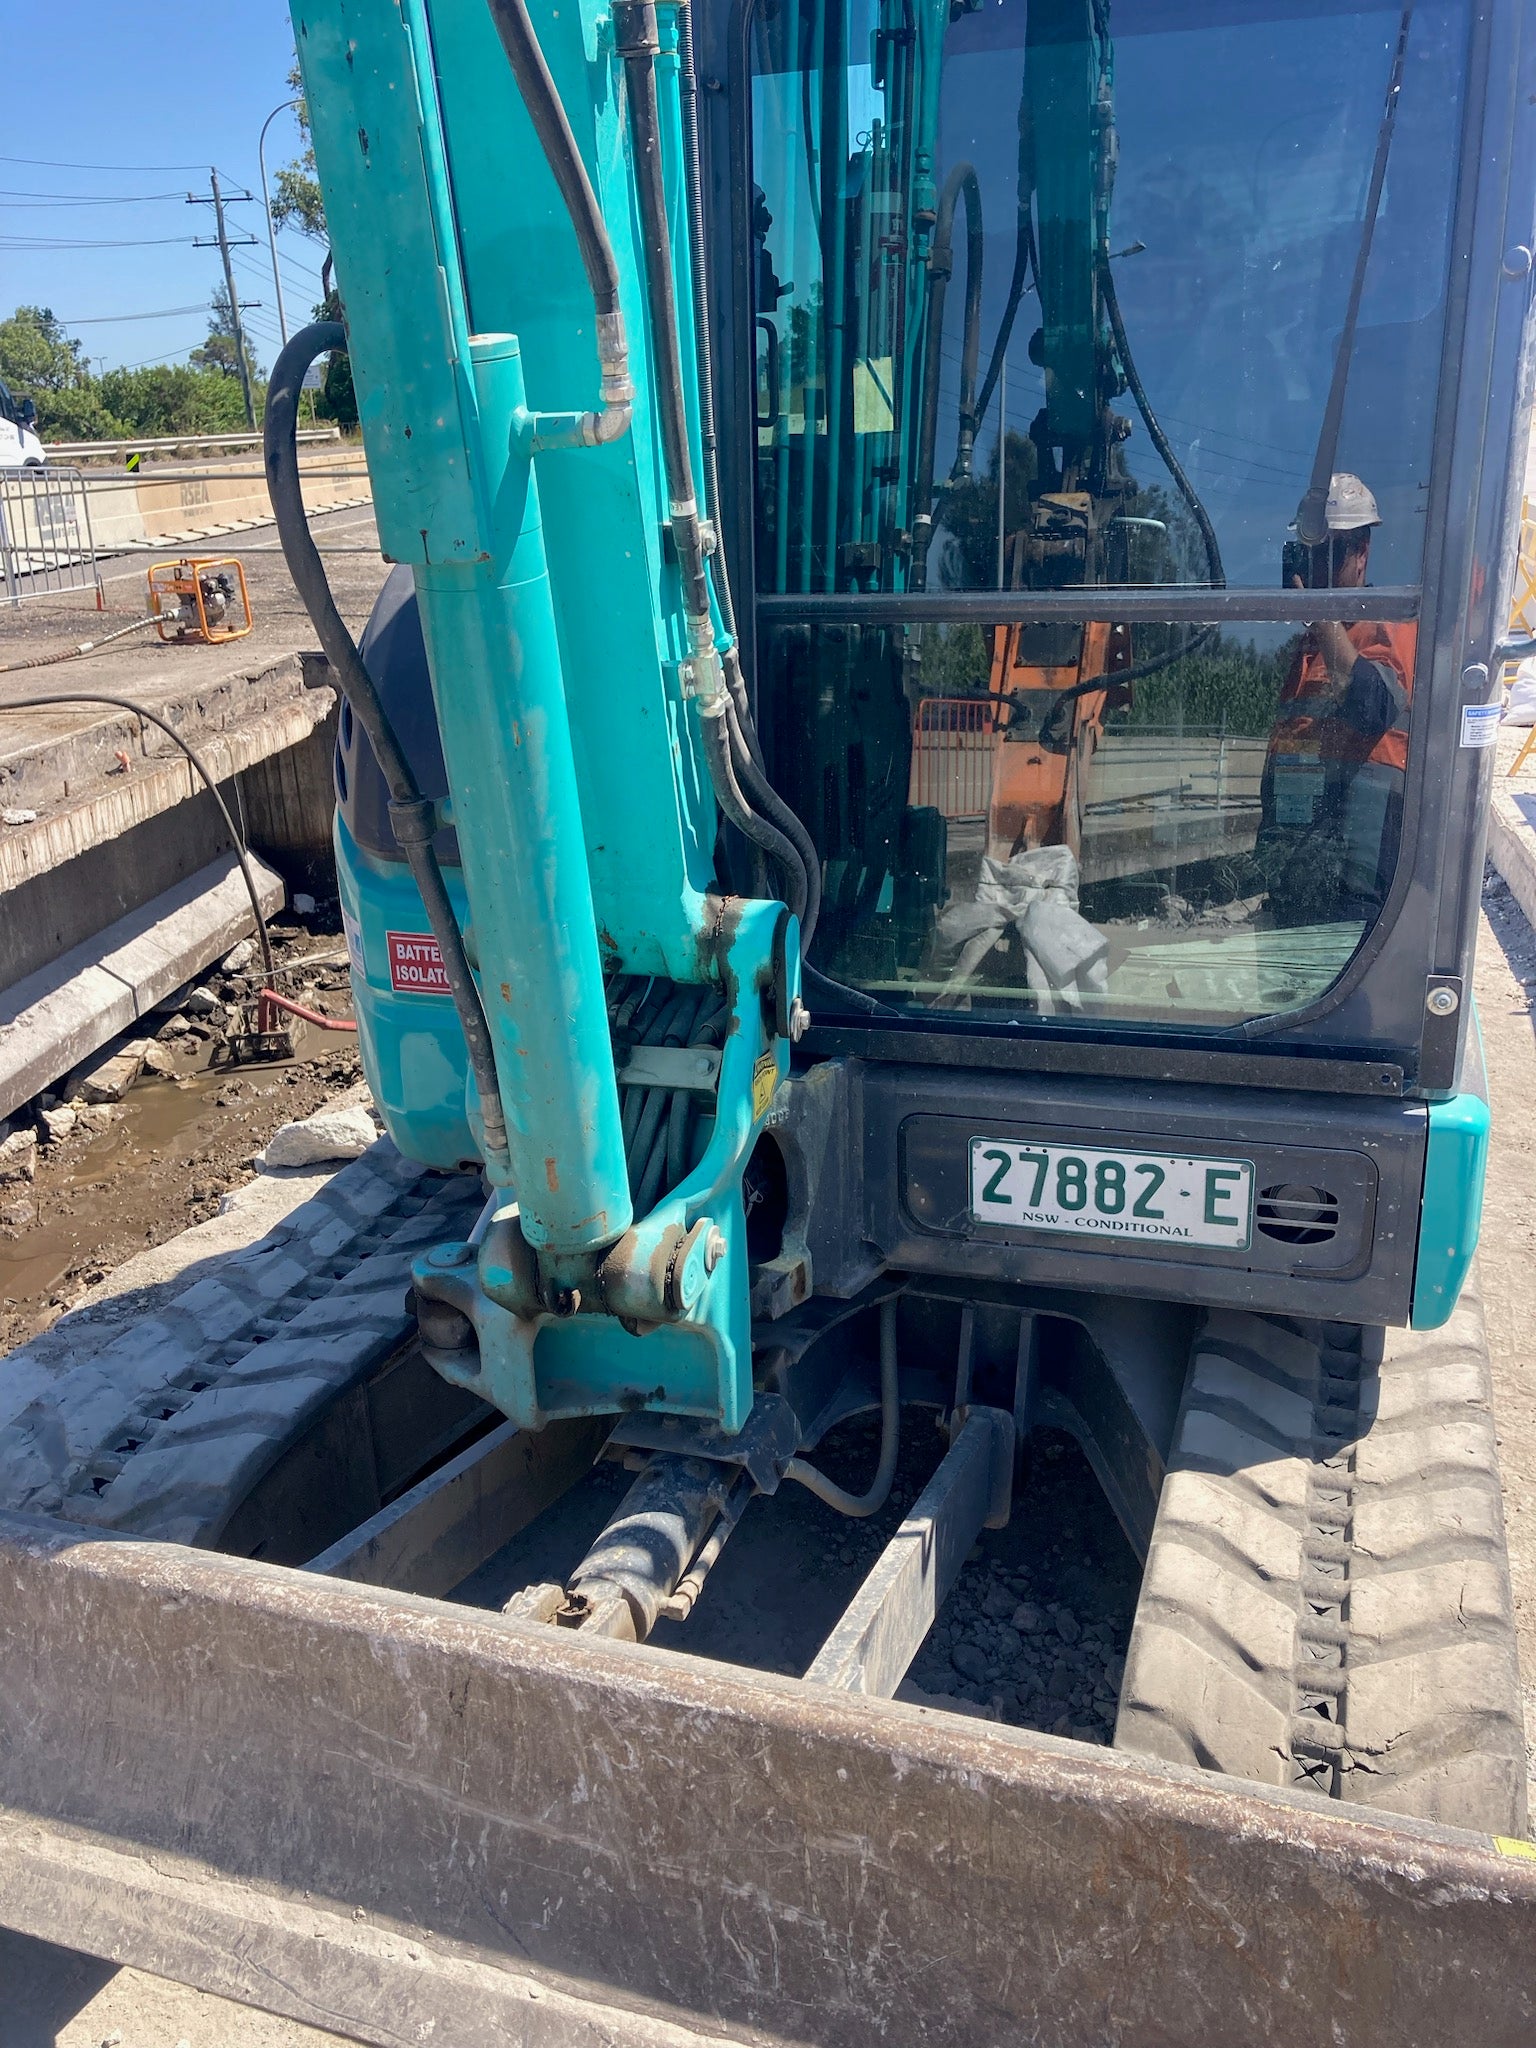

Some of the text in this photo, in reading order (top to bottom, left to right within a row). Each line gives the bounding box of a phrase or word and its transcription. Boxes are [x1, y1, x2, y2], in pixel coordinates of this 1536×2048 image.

[396, 943, 444, 963] BATTE
[1022, 1211, 1060, 1225] NSW
[1074, 1217, 1194, 1238] CONDITIONAL
